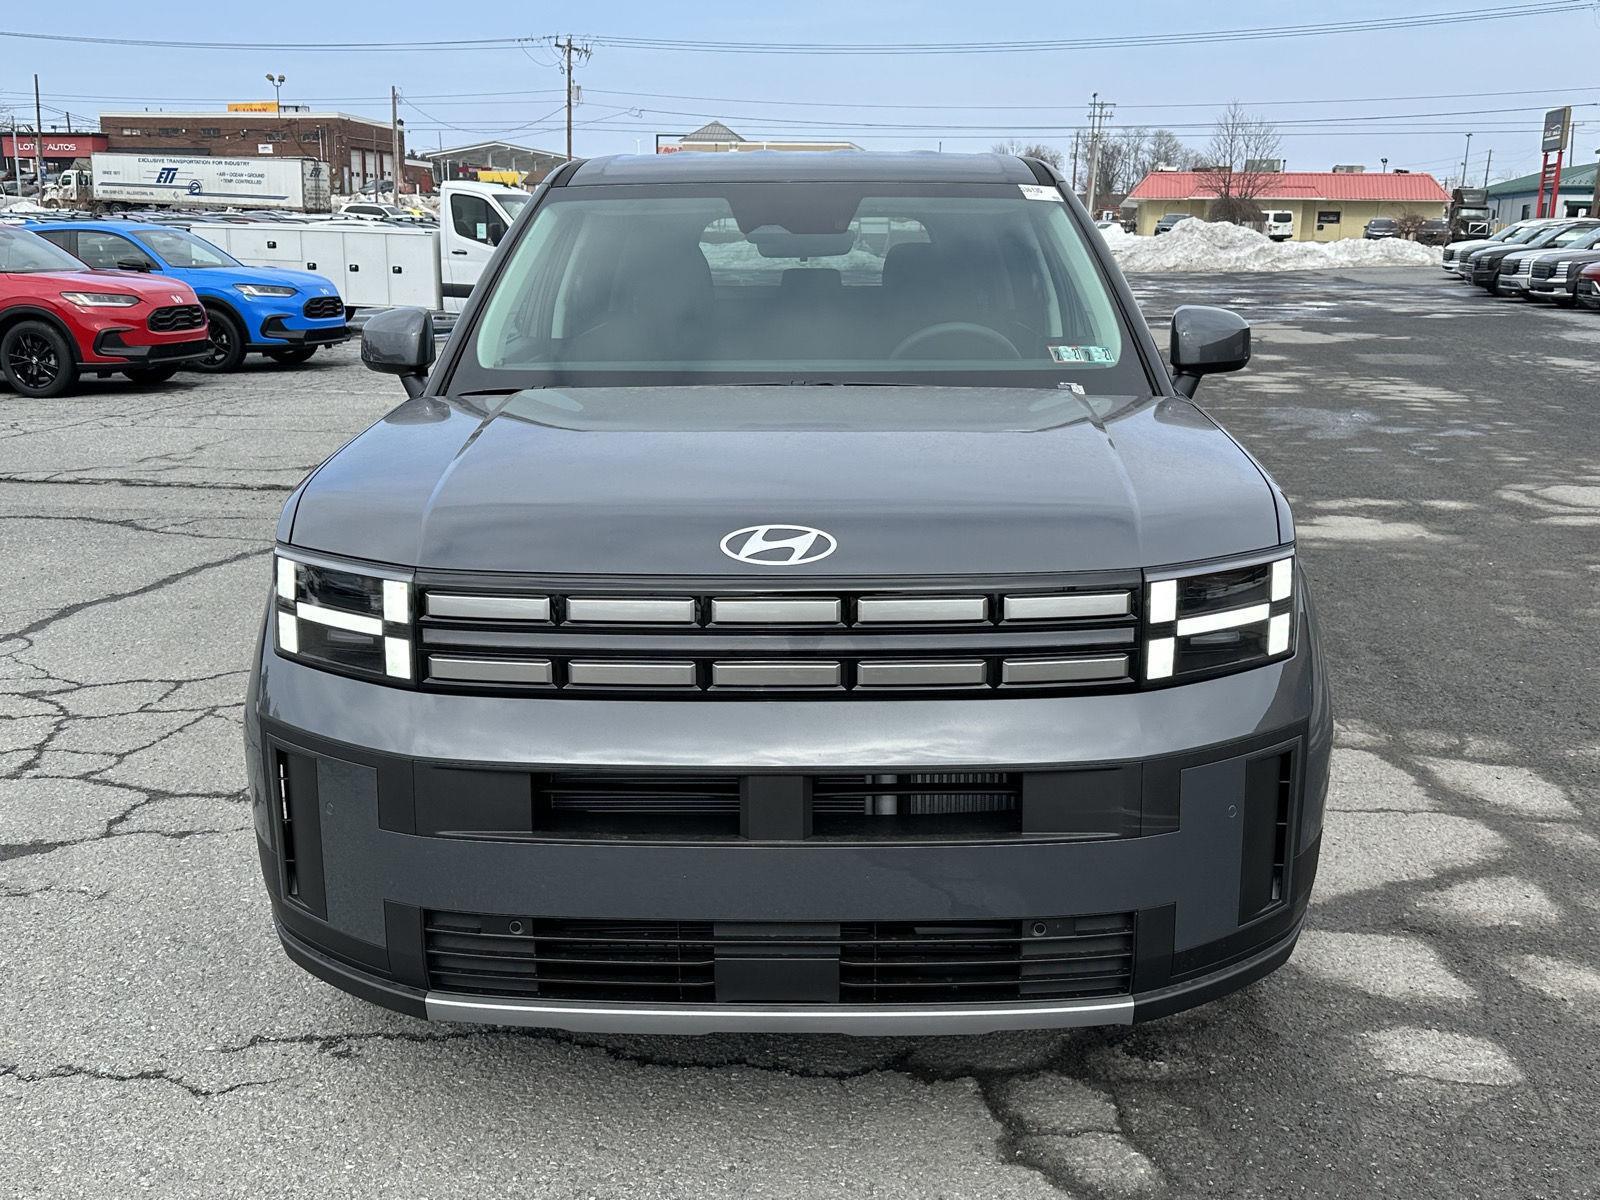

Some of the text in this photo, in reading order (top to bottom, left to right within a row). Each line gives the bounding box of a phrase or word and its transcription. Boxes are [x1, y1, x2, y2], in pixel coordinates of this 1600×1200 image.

[18, 143, 35, 151] LOT
[47, 143, 77, 151] AUTOS
[156, 167, 179, 184] ETI
